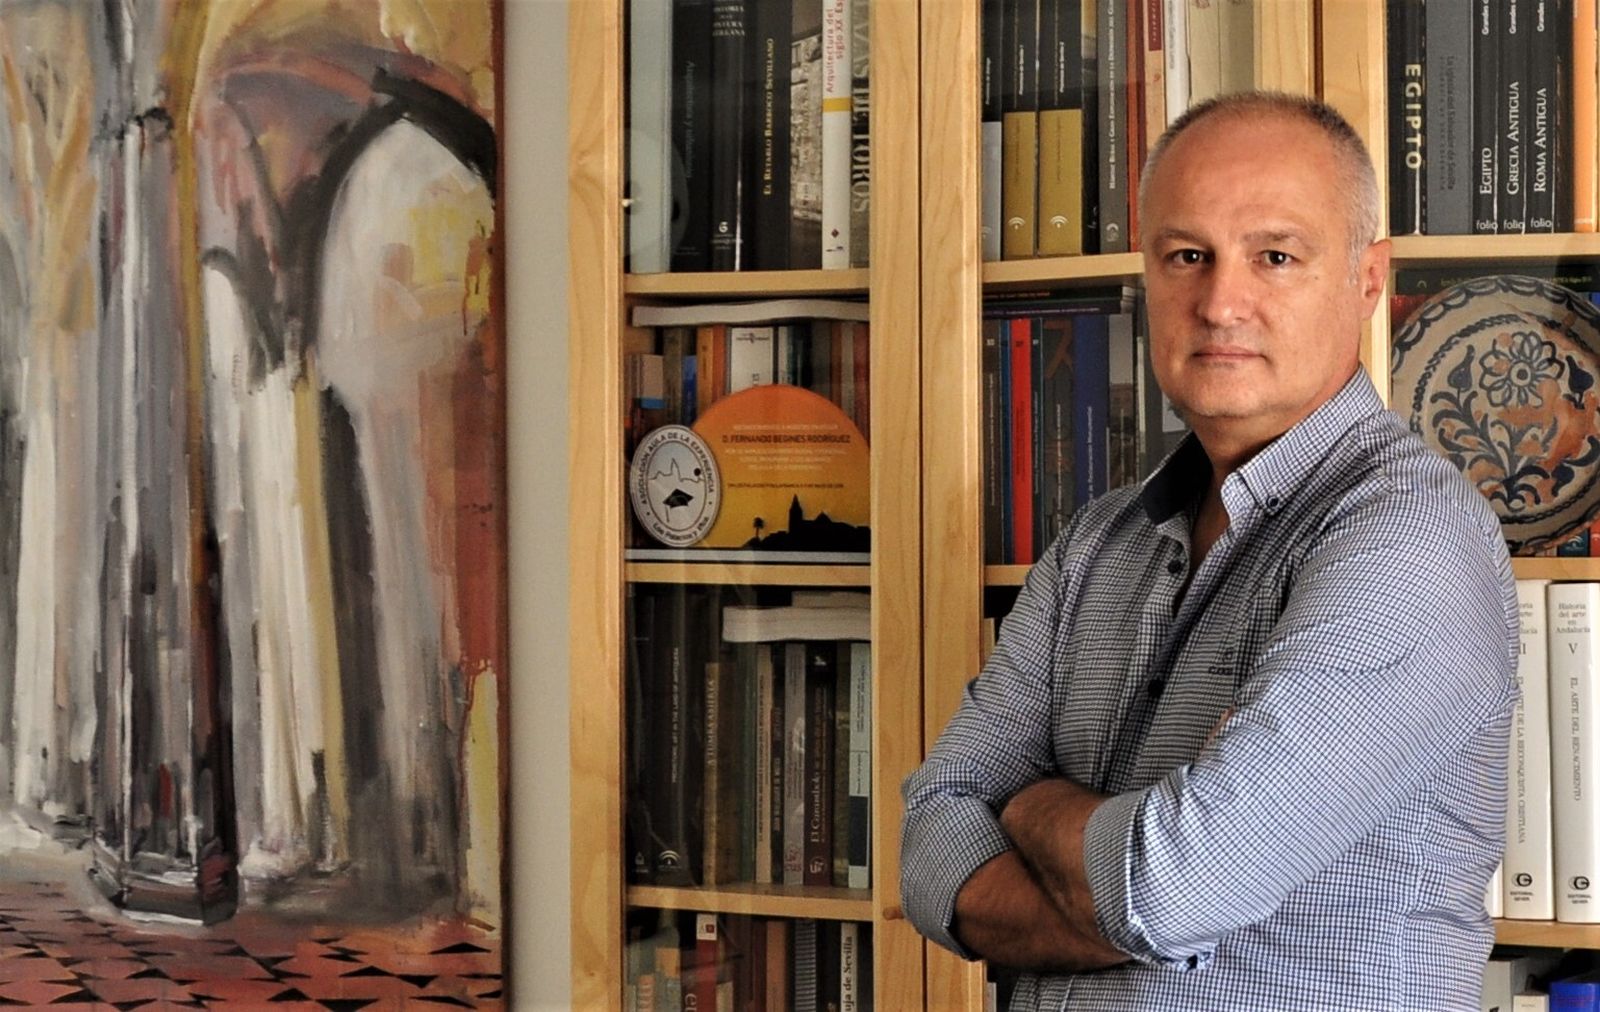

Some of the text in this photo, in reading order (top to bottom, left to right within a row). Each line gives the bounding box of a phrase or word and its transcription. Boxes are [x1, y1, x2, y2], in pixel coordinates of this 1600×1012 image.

[1481, 5, 1489, 35] Grandes
[1508, 4, 1516, 34] Grandes
[1537, 2, 1545, 32] Grandes
[836, 36, 845, 60] siglo
[826, 29, 836, 93] Arquitectura
[1406, 64, 1422, 169] EGIPTO
[1506, 81, 1520, 195] GRECIA ANTIGUA
[1533, 87, 1547, 193] ROMA ANTIGUA
[1479, 147, 1493, 195] EGIPTO
[1476, 218, 1498, 231] folio
[1503, 218, 1525, 231] folio
[1530, 217, 1553, 230] folio
[648, 433, 667, 452] AULA
[680, 433, 690, 444] LA
[731, 434, 772, 444] FERNANDO
[1557, 602, 1587, 611] Historia
[1558, 611, 1569, 619] del
[1568, 642, 1579, 655] V
[1517, 713, 1525, 725] DE
[1517, 727, 1525, 739] LA
[1570, 677, 1582, 801] EL ARTE DEL RENACIMIENTO
[1518, 799, 1526, 845] CRISTIANA
[842, 936, 853, 975] Sevilla
[843, 977, 852, 992] de
